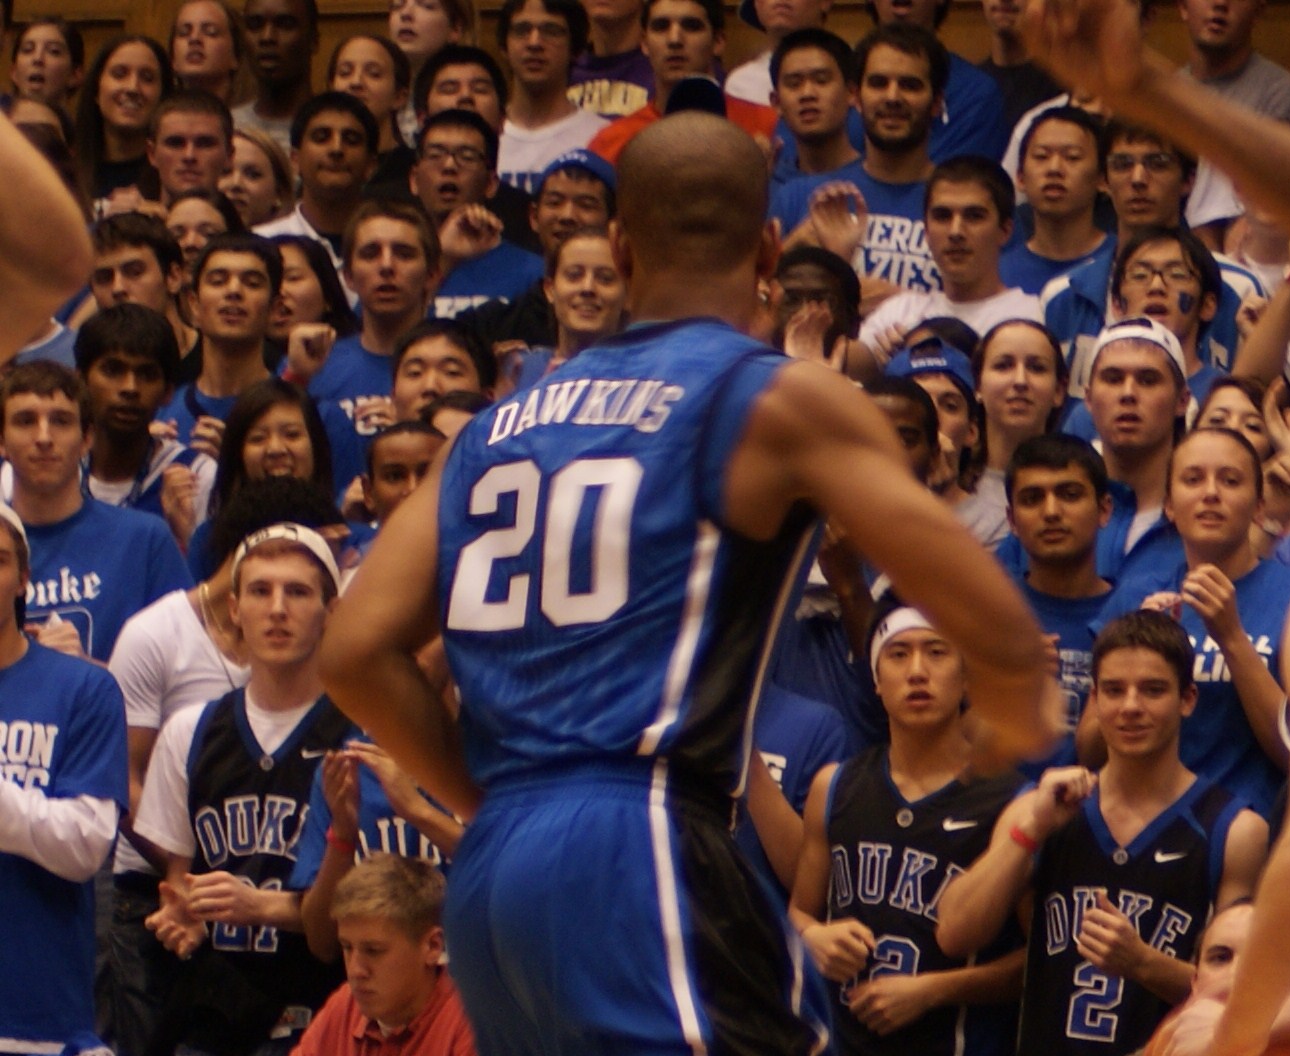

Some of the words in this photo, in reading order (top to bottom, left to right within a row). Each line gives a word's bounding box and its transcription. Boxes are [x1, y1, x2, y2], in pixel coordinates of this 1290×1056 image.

[488, 379, 685, 446] DAWKINS
[448, 458, 644, 632] 20
[195, 794, 310, 868] DUK
[1066, 960, 1125, 1043] 2
